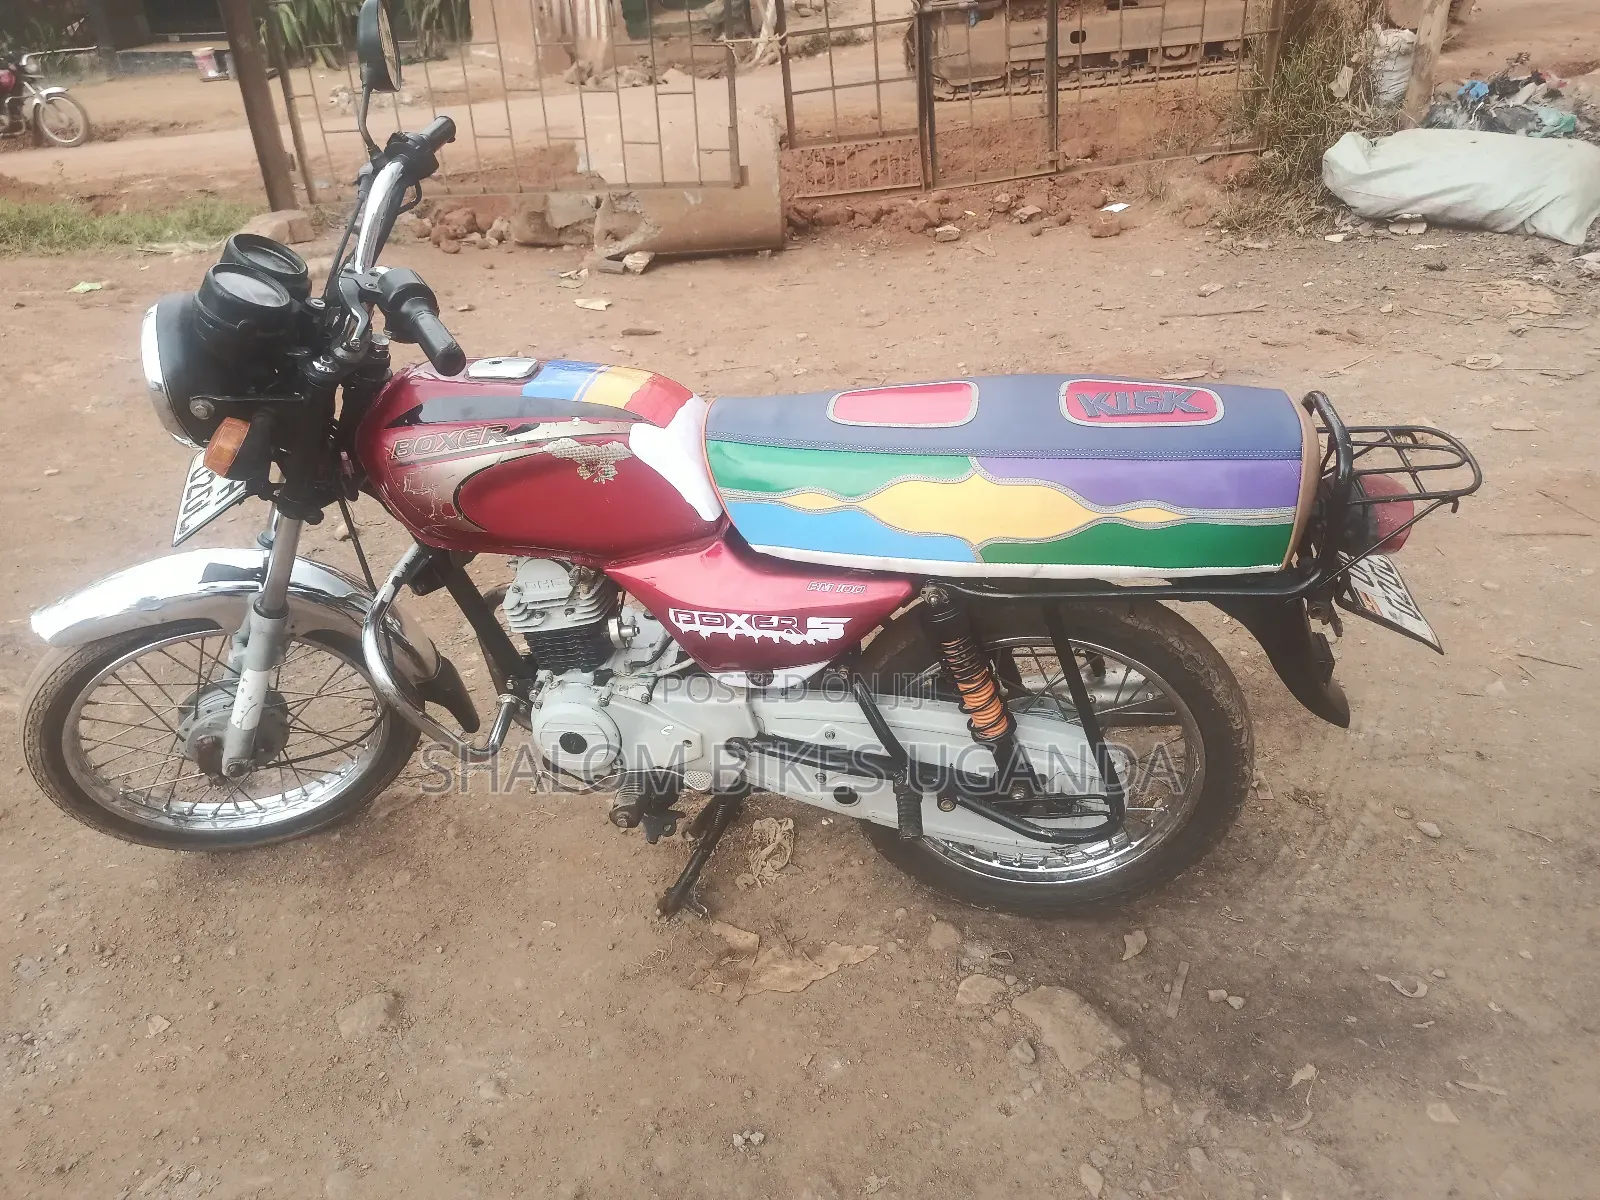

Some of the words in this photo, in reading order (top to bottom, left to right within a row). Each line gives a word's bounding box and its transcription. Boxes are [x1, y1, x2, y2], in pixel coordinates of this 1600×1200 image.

[391, 424, 511, 459] BOXER
[806, 582, 835, 592] BM
[836, 584, 867, 594] 100
[668, 608, 804, 638] BOXER
